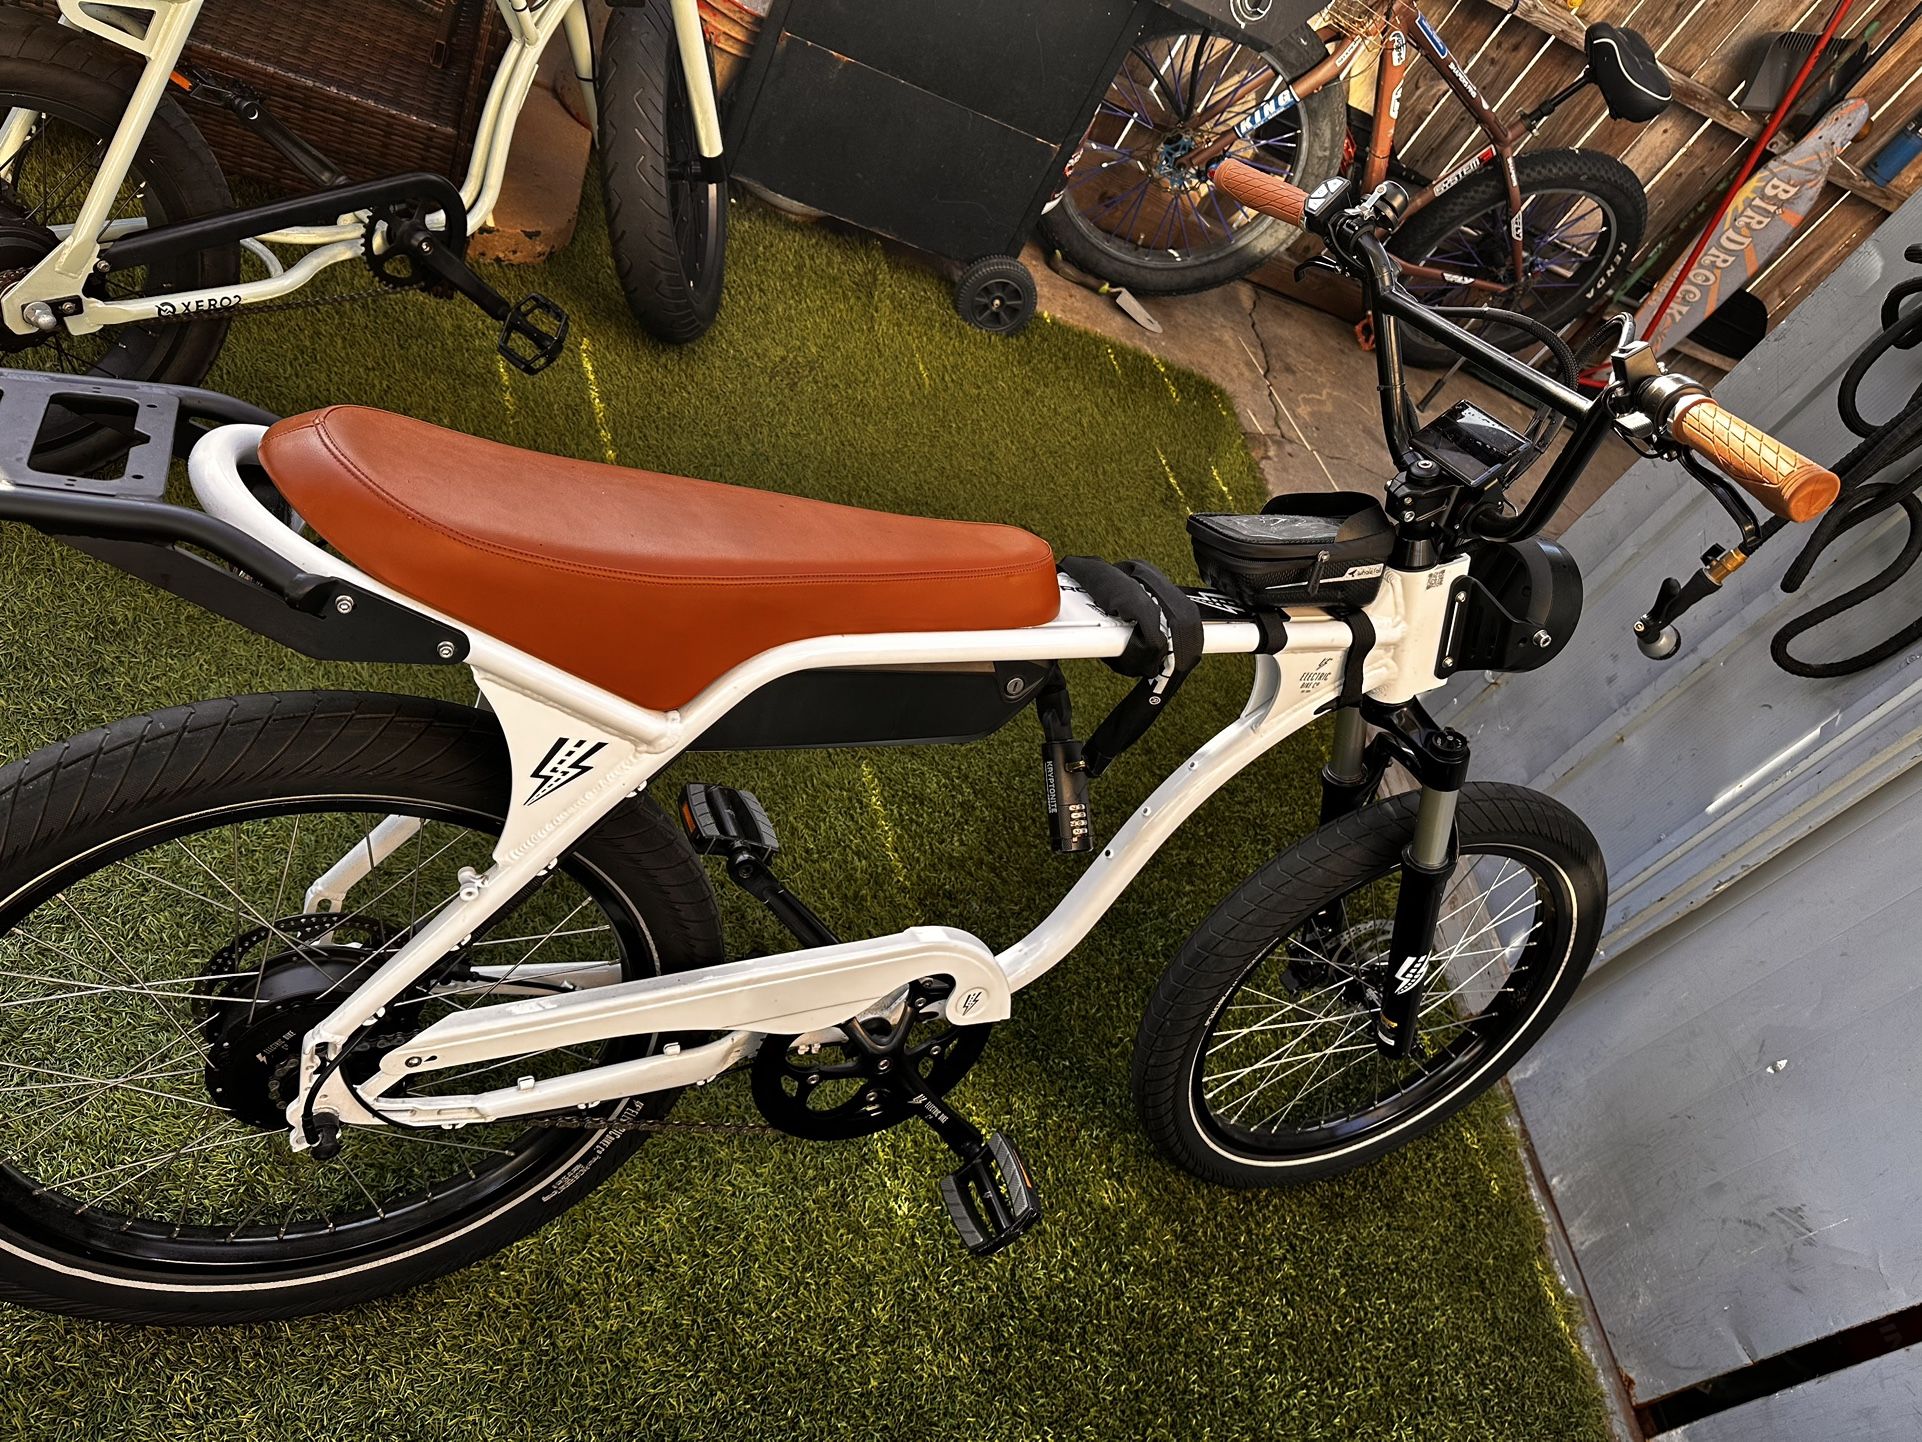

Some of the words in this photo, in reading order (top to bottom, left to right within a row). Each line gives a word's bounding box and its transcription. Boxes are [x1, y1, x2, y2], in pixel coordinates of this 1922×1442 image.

[1239, 88, 1292, 134] KING
[1434, 157, 1480, 195] SYSTEM
[1585, 242, 1628, 299] KENDA
[1663, 176, 1801, 323] BIRDROCK
[1299, 672, 1331, 681] ELECTRIC
[1046, 760, 1058, 813] KRYPTONITE
